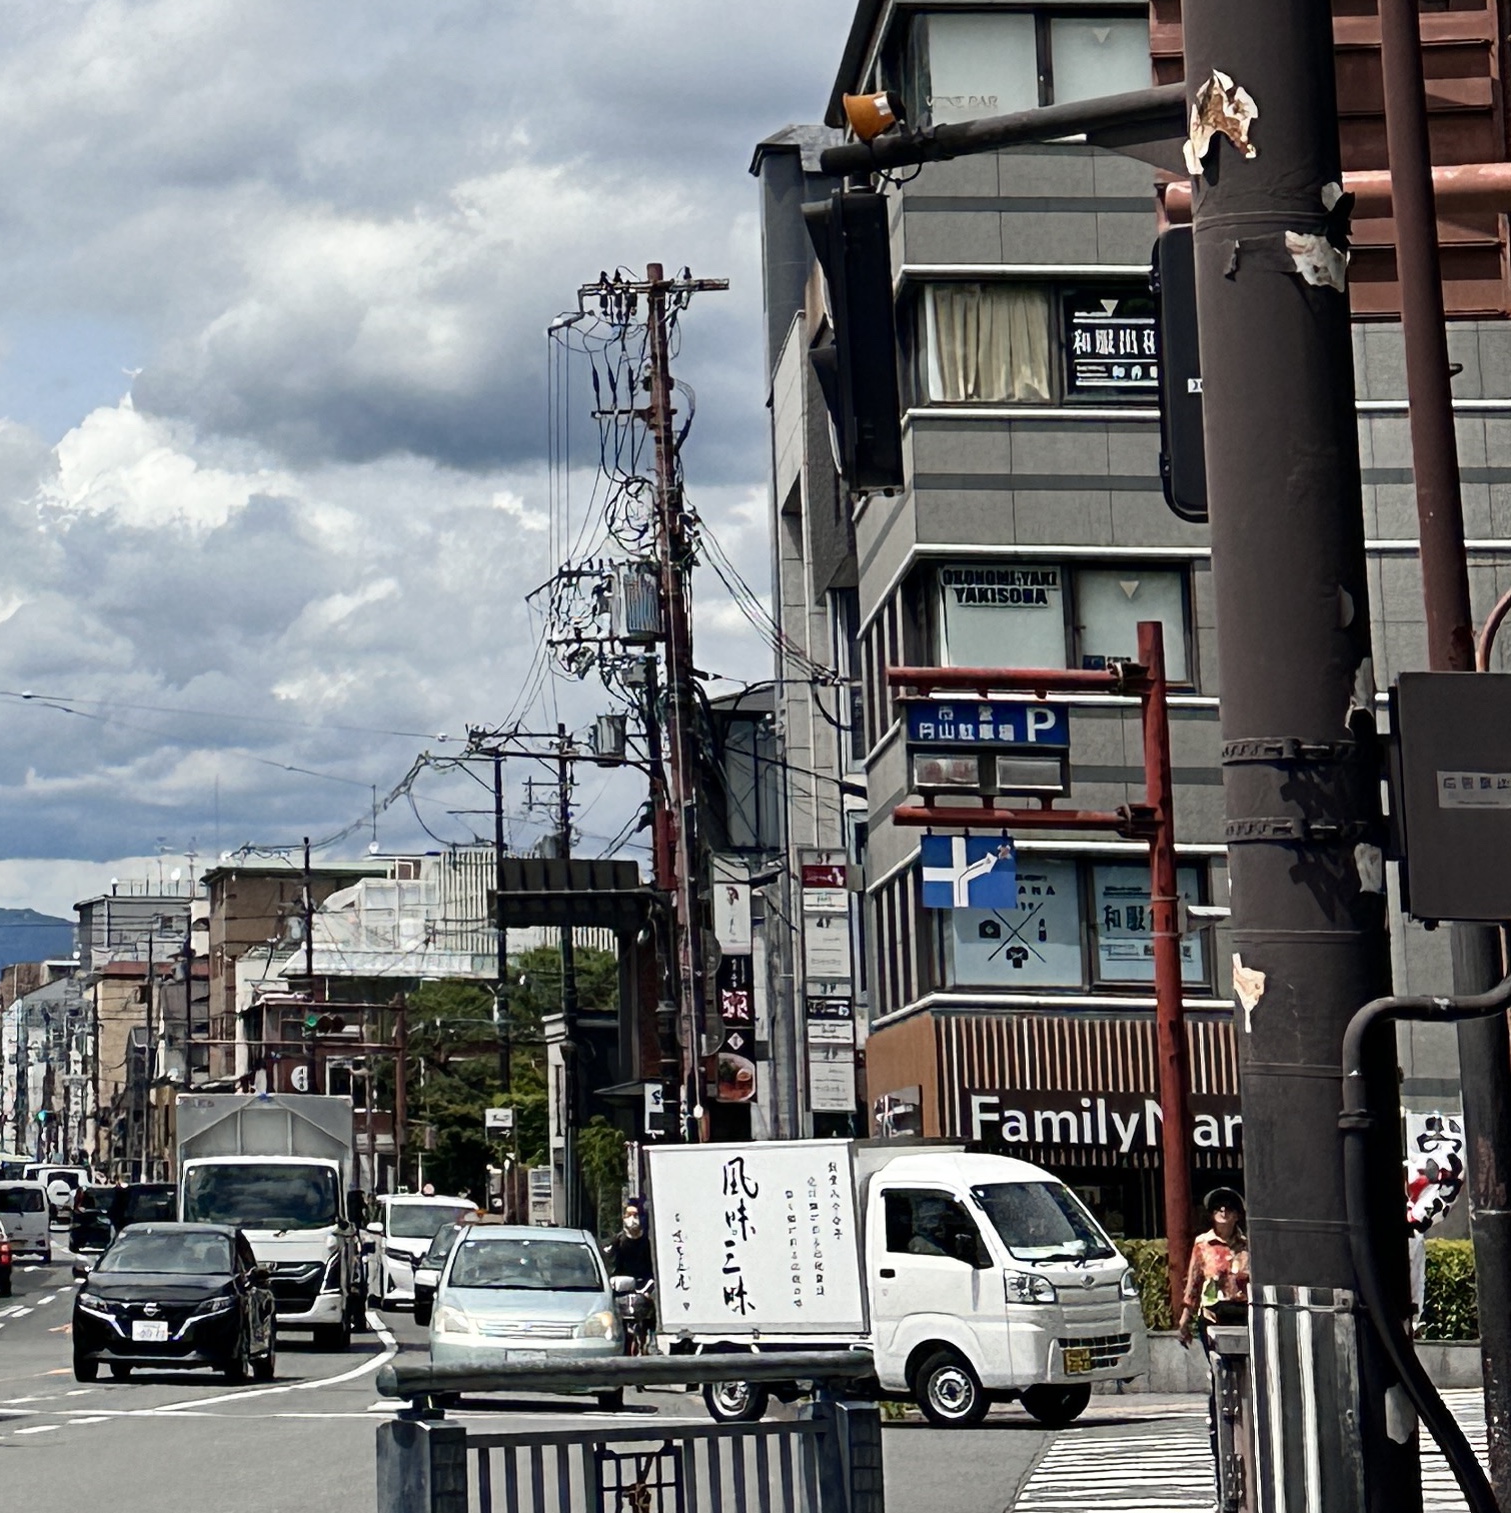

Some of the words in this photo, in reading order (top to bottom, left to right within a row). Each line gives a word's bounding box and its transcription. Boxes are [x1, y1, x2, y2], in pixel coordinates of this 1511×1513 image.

[953, 587, 1048, 604] YAKISOBA
[1026, 707, 1057, 742] P
[970, 1093, 1243, 1154] Familyar
